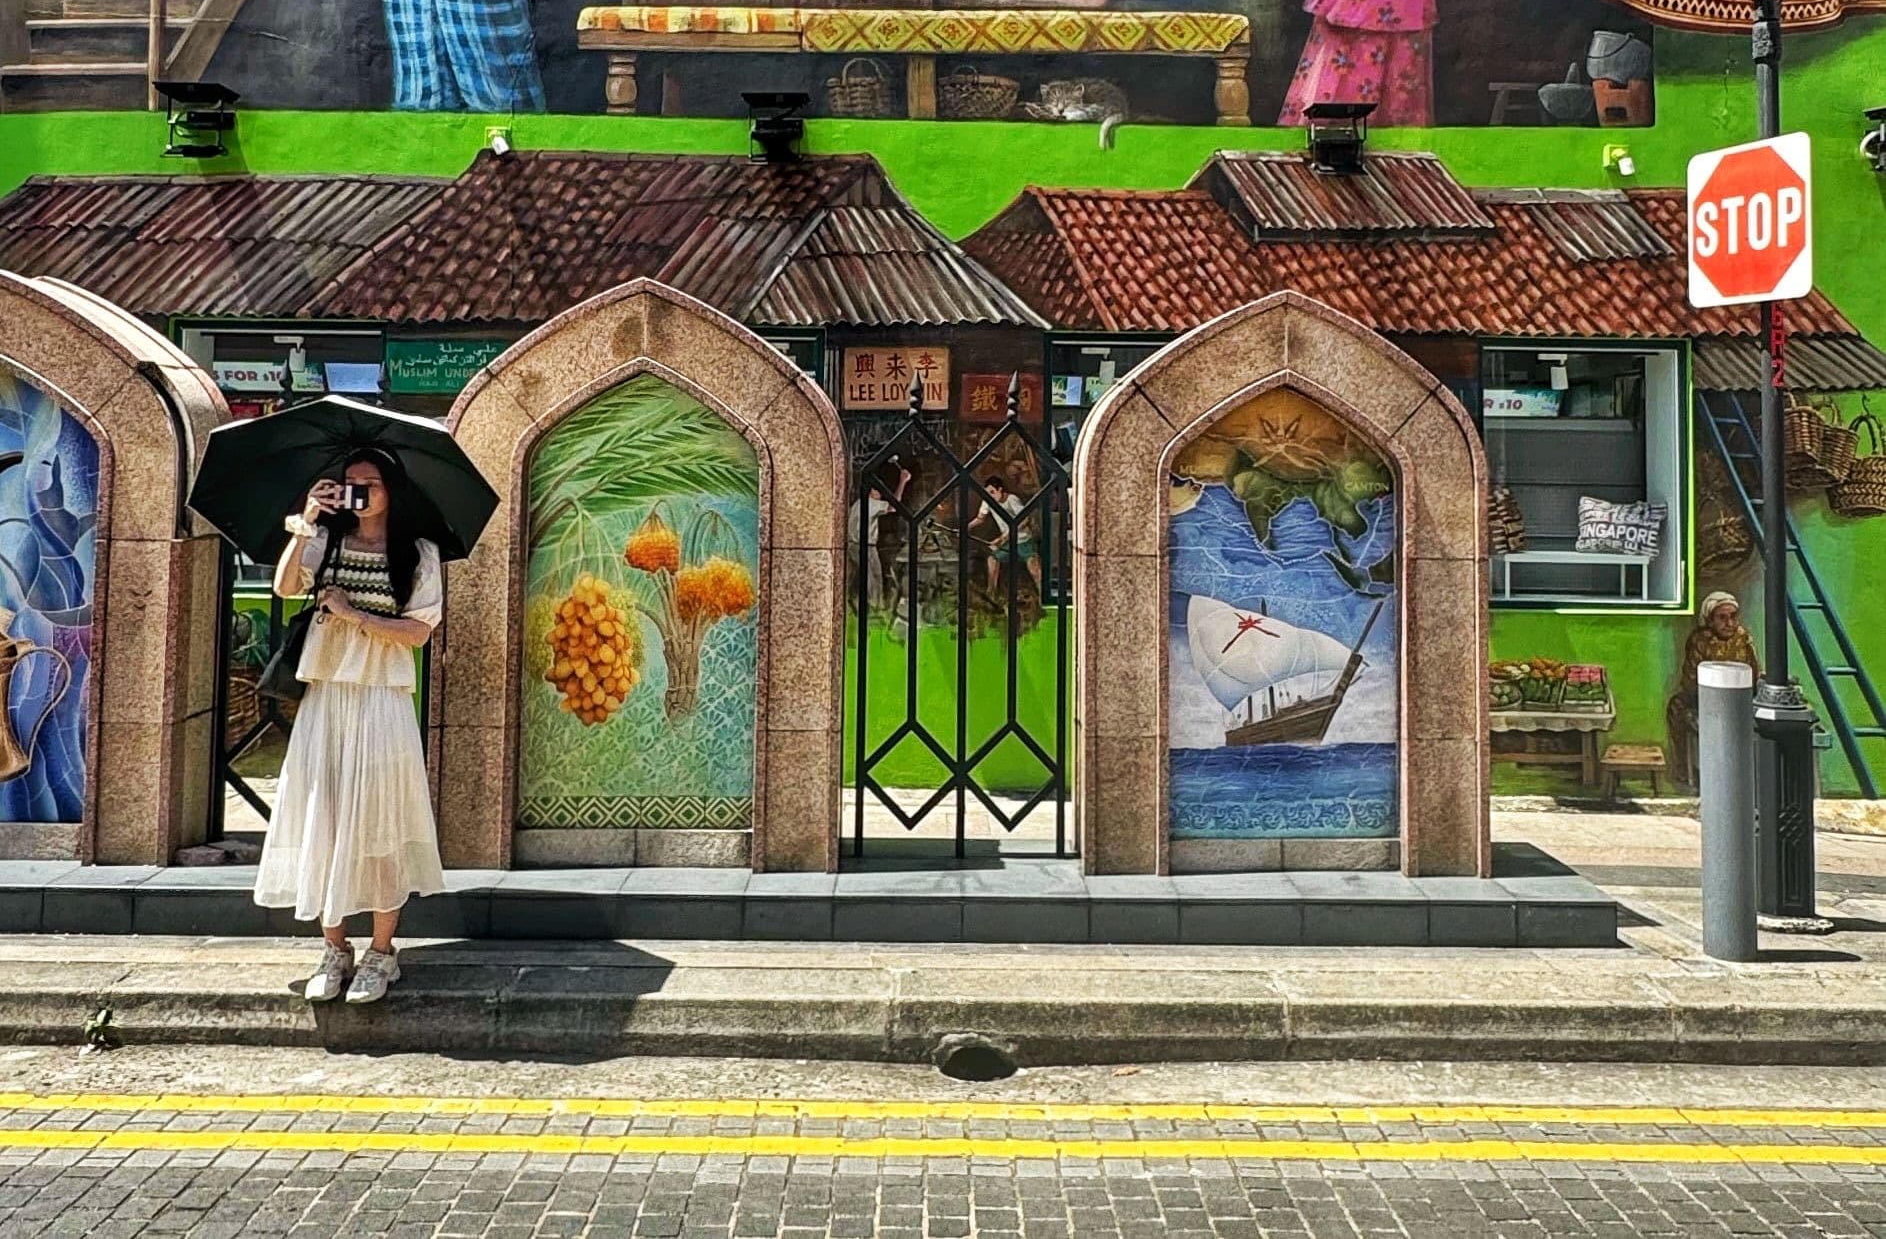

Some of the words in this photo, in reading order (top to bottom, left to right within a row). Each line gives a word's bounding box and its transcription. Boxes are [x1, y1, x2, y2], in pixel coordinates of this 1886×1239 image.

[1696, 186, 1802, 258] STOP
[224, 370, 258, 381] FOR
[389, 359, 438, 378] MUSLIM
[850, 384, 876, 401] LEE
[882, 383, 909, 401] LOY
[1344, 482, 1389, 492] CANTON
